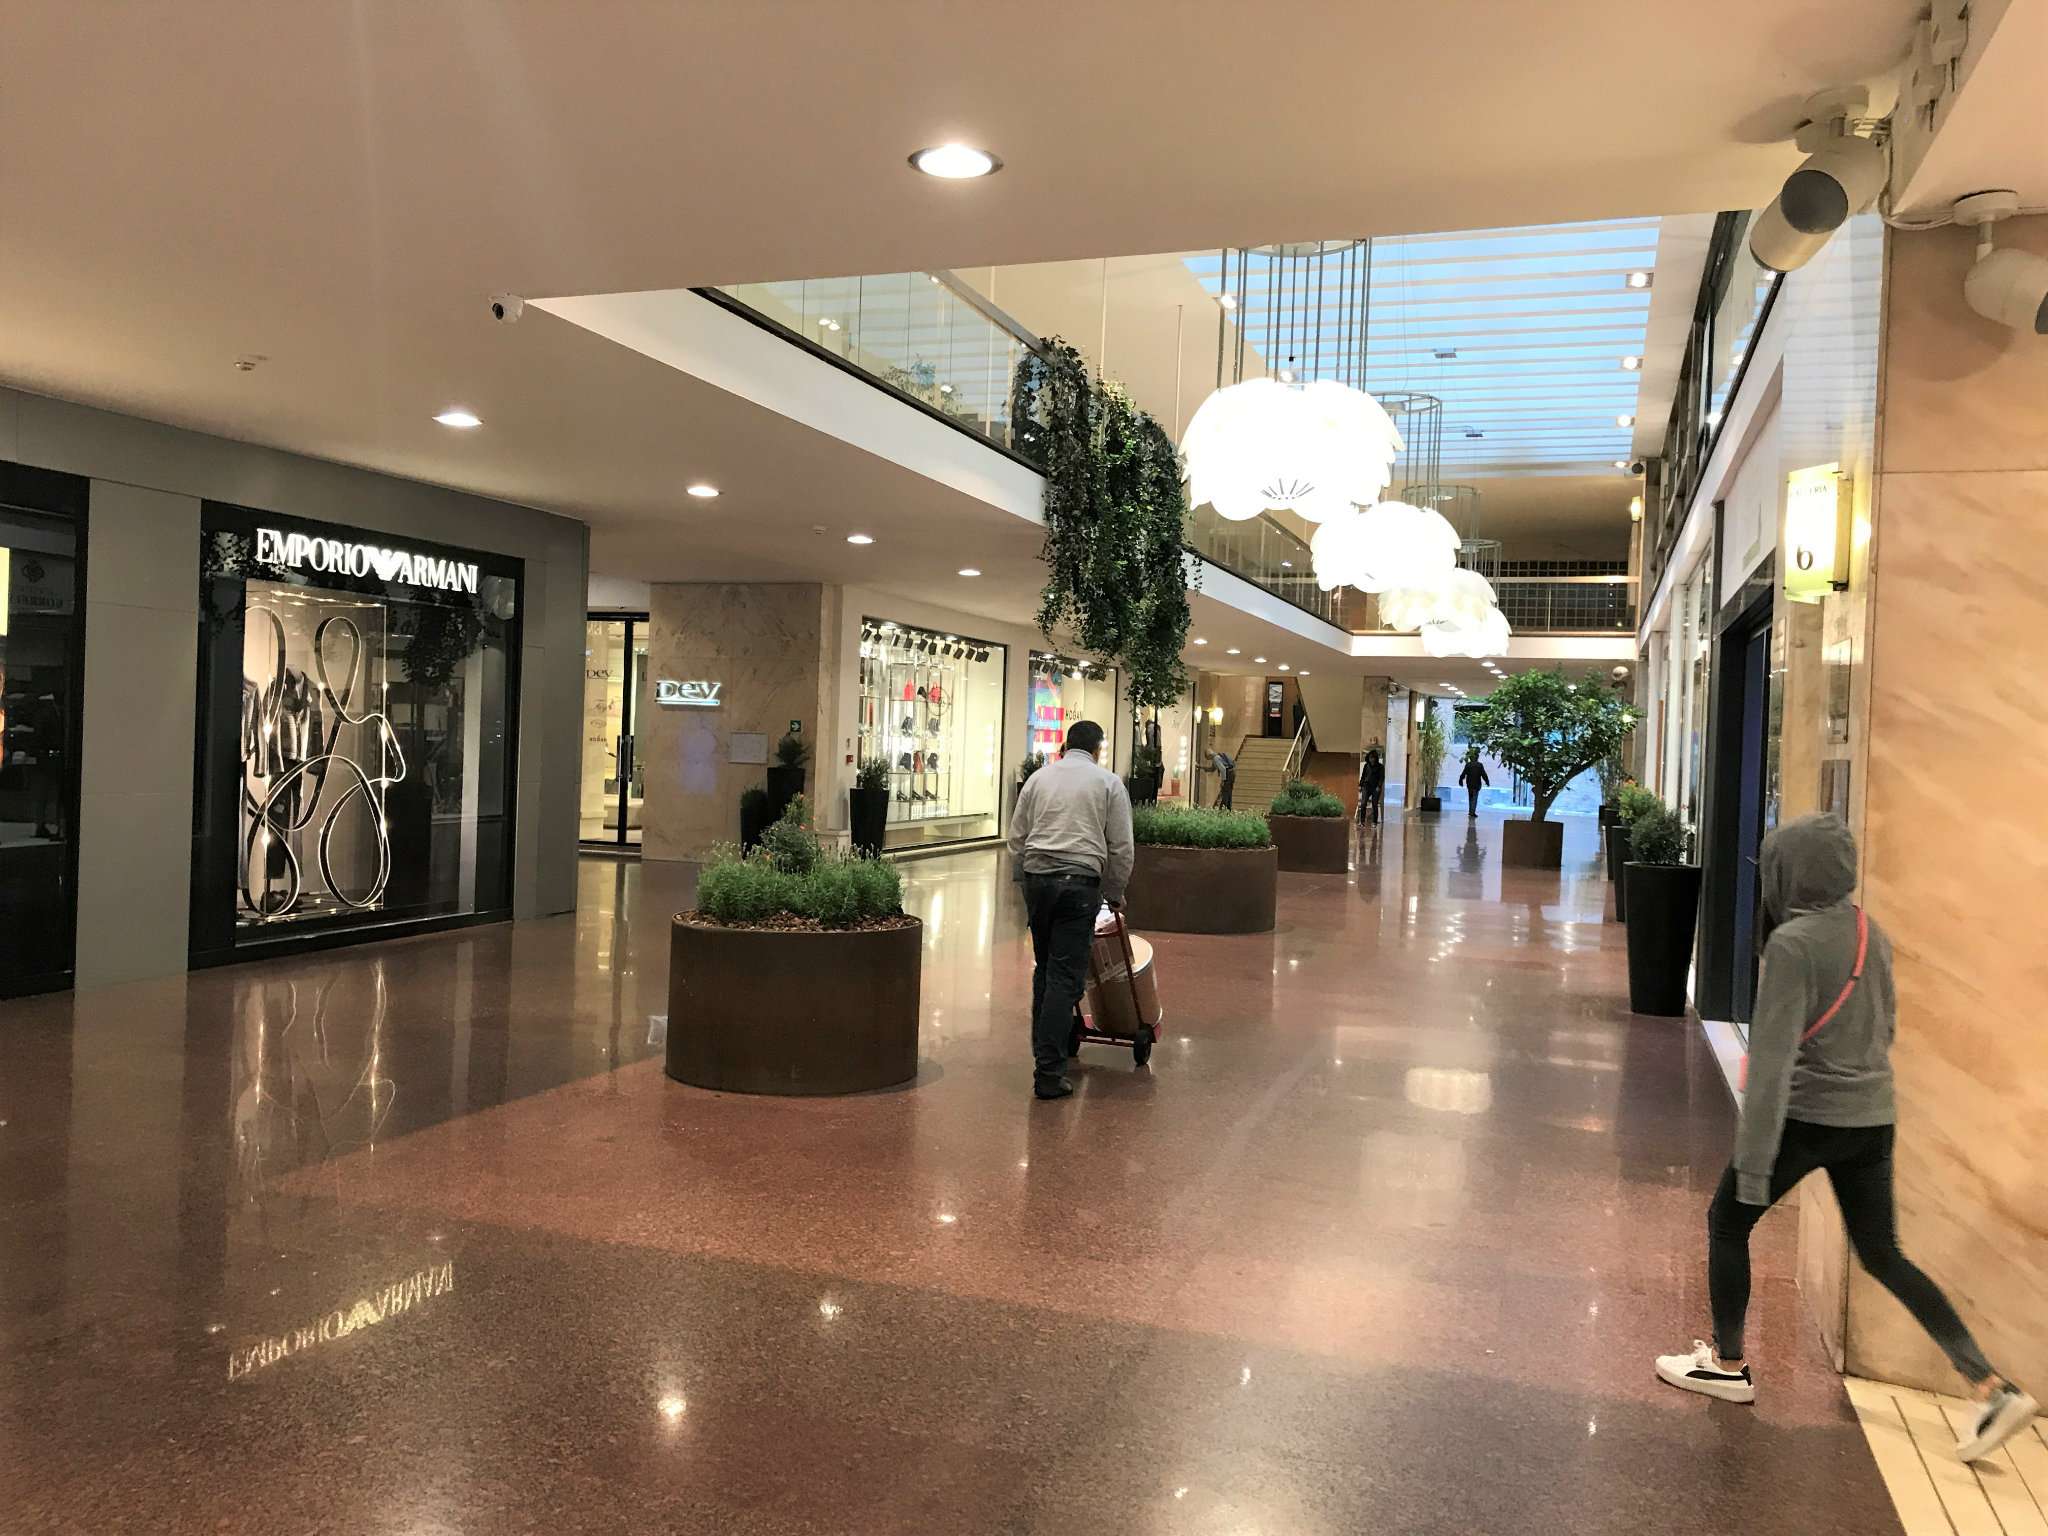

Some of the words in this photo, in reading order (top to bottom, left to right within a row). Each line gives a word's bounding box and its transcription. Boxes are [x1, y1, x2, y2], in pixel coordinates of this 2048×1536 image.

[256, 527, 371, 577] EMPORIO
[398, 551, 478, 594] ARMANI
[1796, 544, 1813, 571] 6
